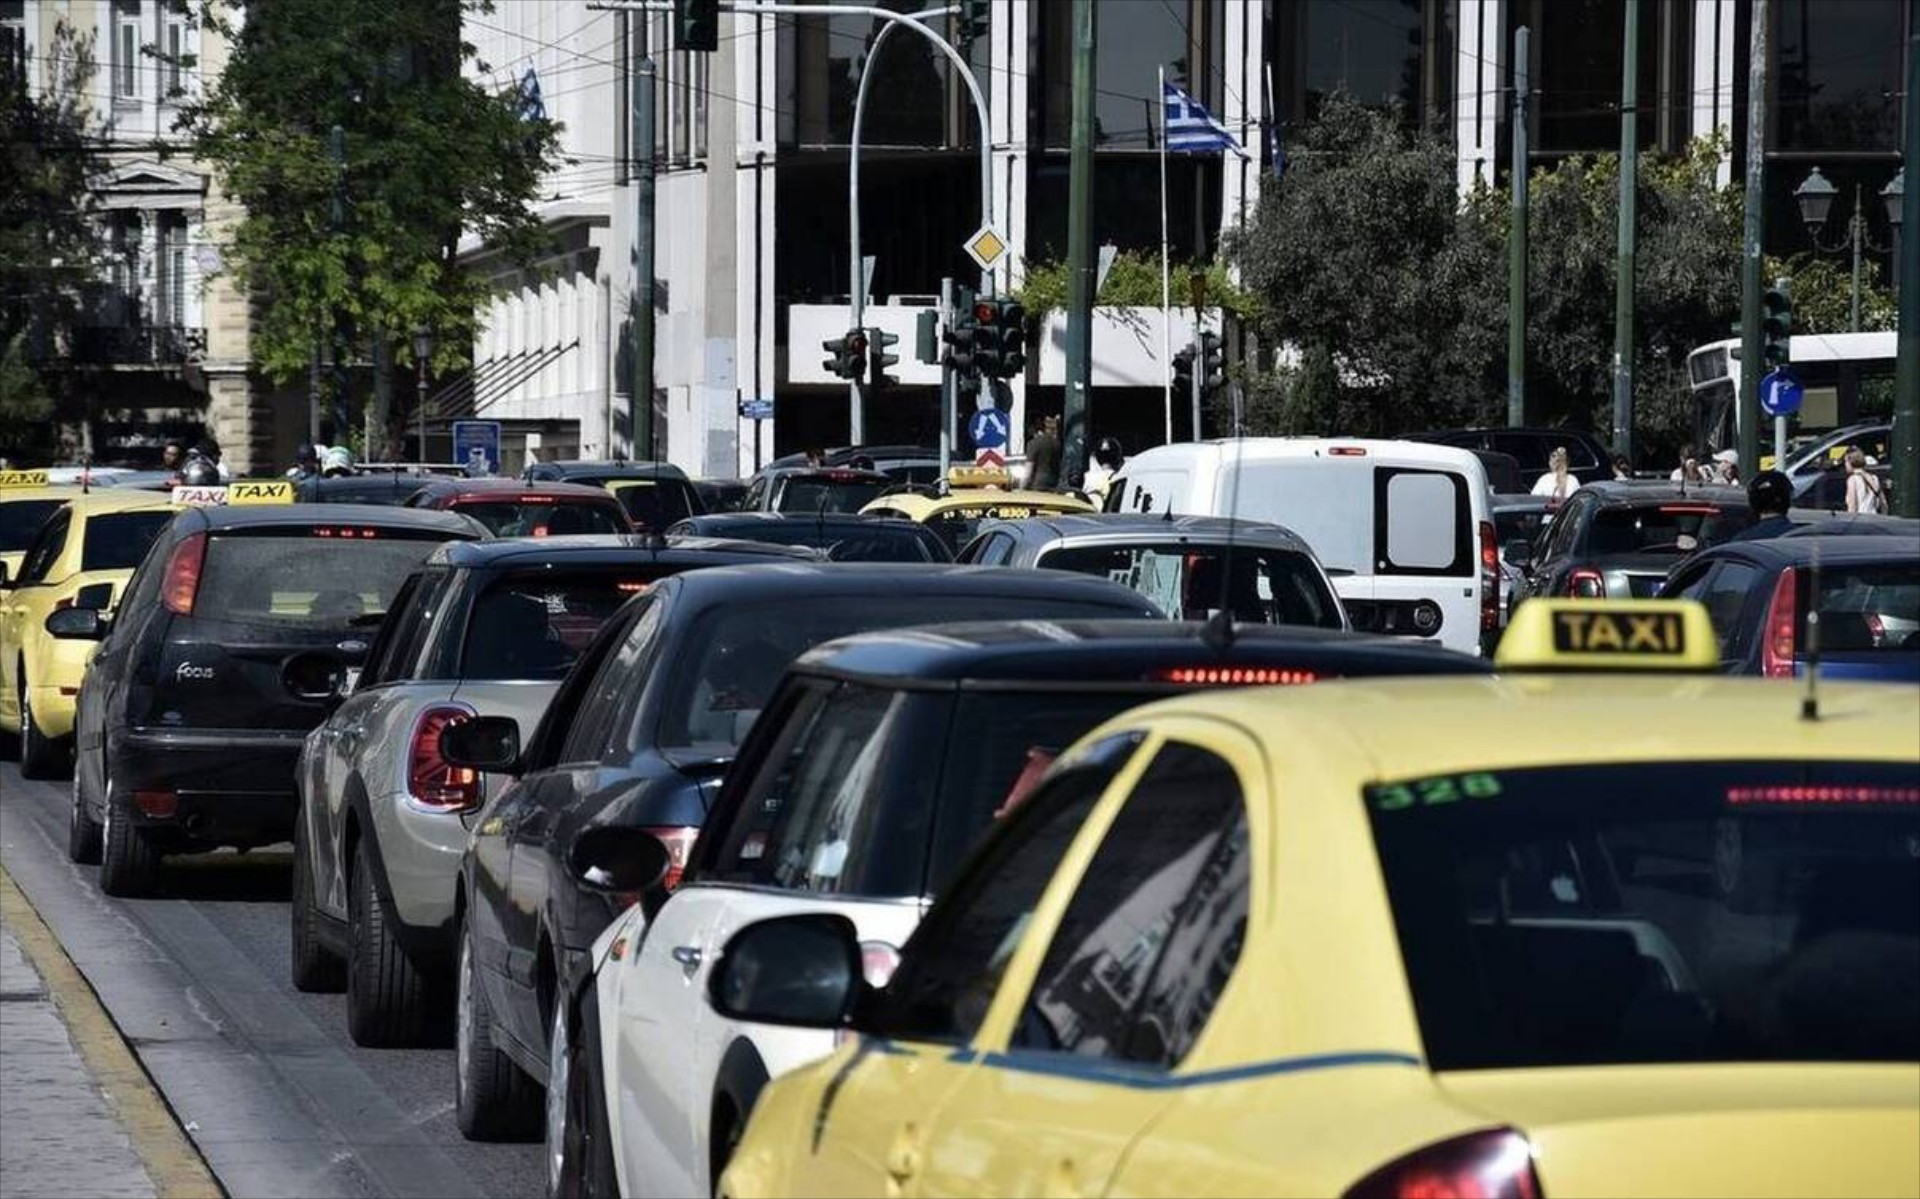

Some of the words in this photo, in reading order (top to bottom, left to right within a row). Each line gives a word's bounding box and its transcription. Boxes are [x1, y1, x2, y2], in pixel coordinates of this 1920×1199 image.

[178, 489, 225, 503] TAXI
[232, 485, 287, 498] TAXI
[1559, 613, 1680, 651] TAXI
